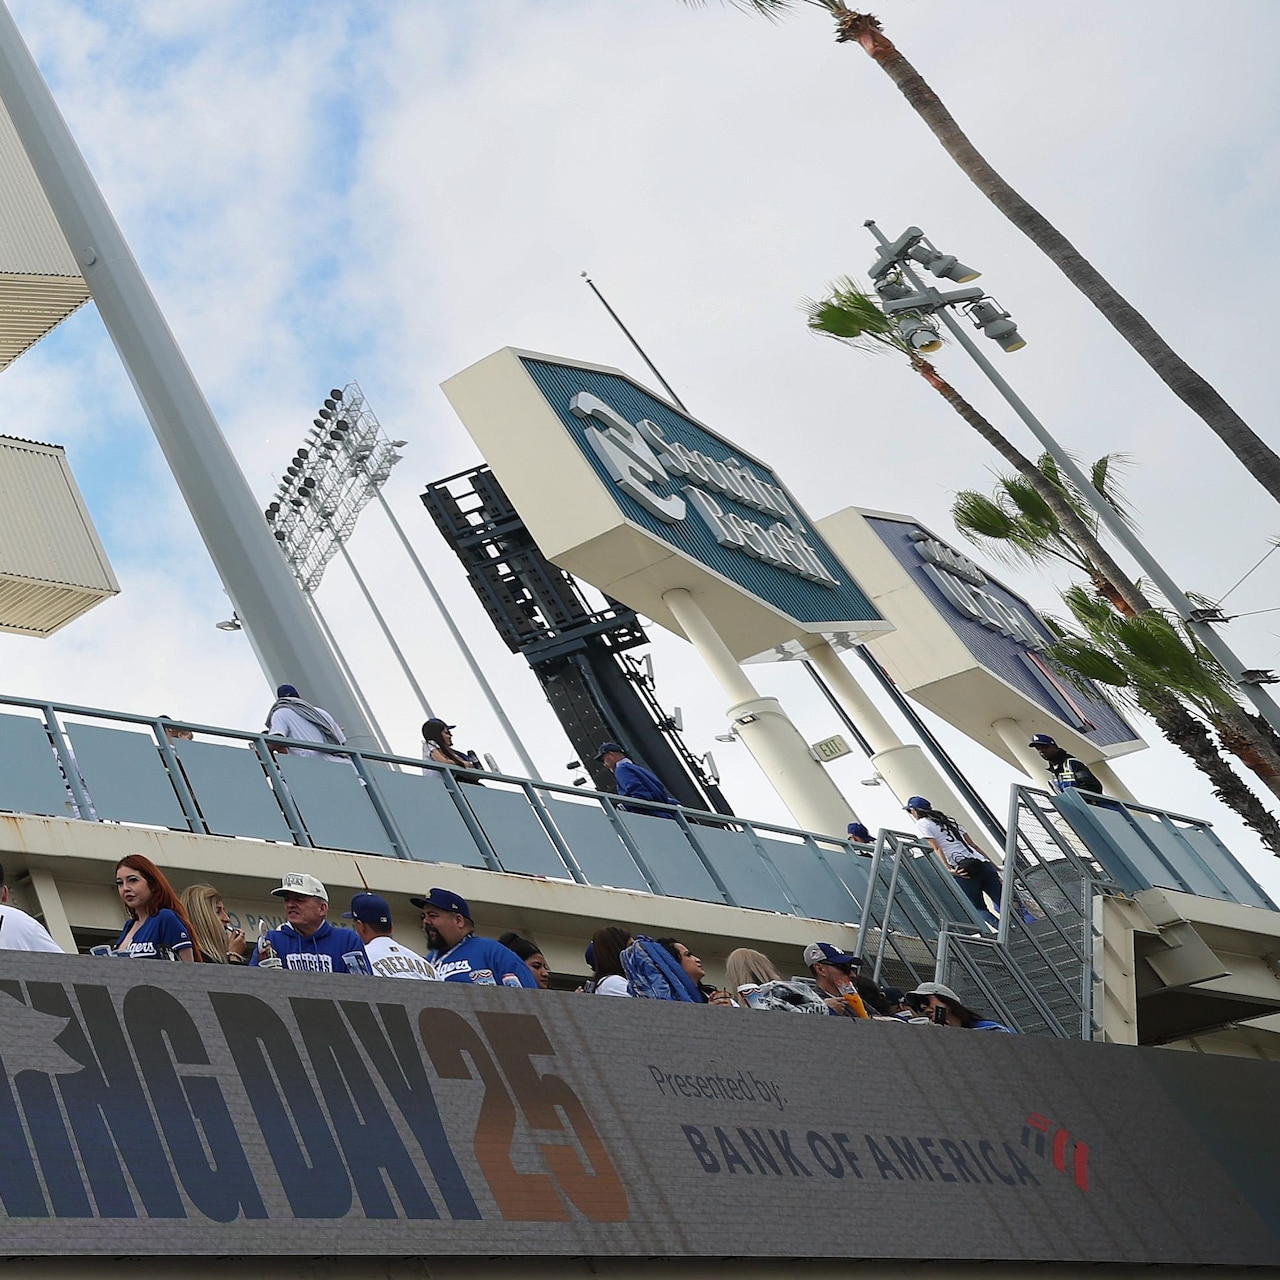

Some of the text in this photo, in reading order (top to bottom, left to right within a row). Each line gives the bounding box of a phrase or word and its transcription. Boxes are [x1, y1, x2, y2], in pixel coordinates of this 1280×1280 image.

[637, 418, 807, 534] Security
[681, 485, 840, 588] Benefit
[819, 739, 842, 758] EXIT
[372, 955, 437, 979] FREEMAN
[647, 1064, 789, 1111] Presented by:
[680, 1124, 1042, 1187] BANK OF AMERICA
